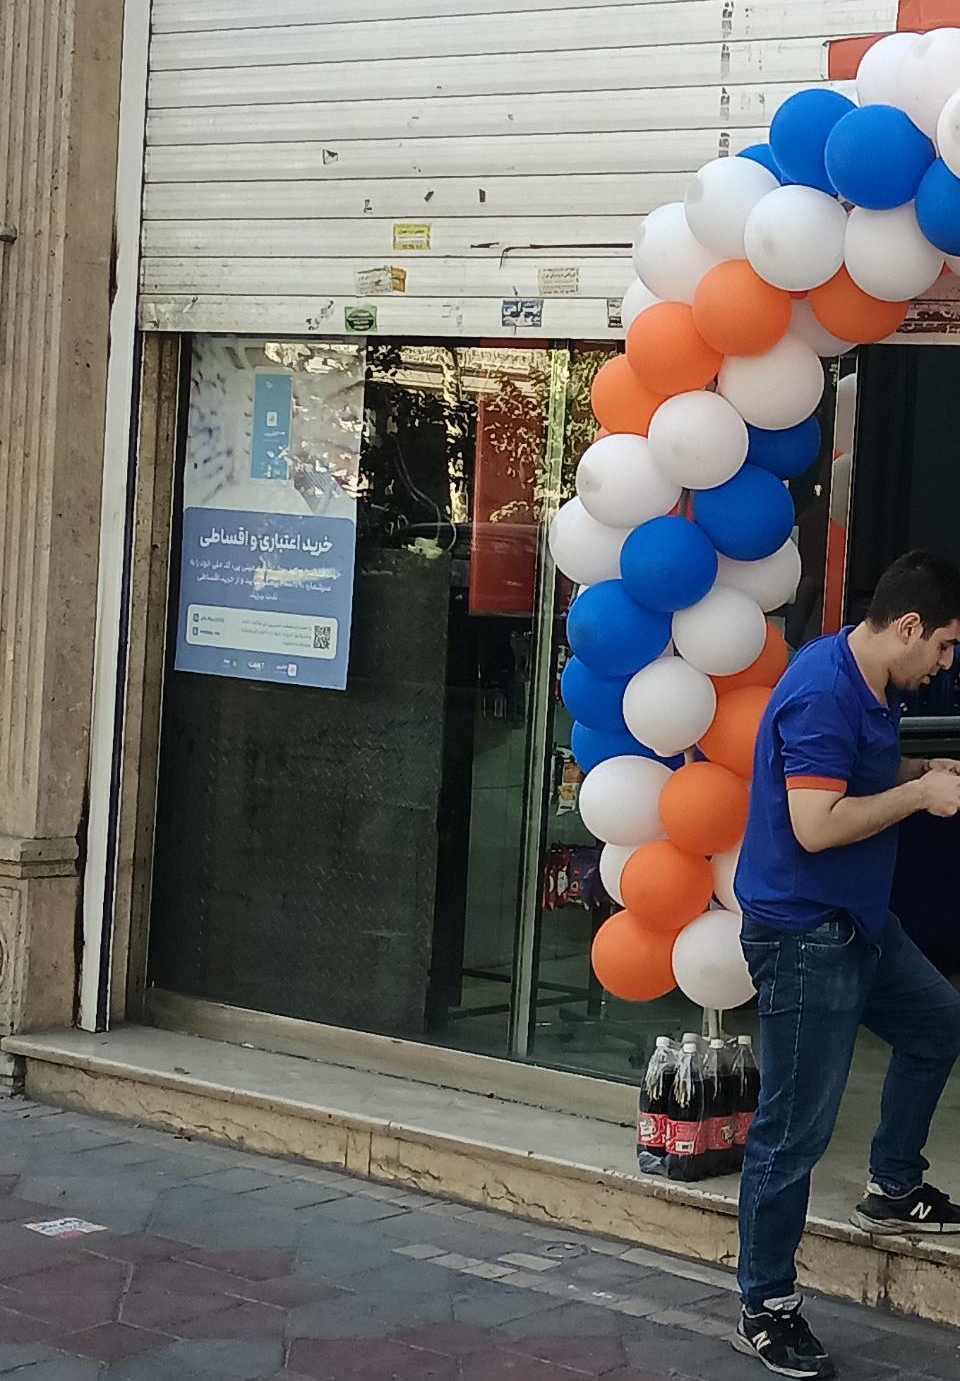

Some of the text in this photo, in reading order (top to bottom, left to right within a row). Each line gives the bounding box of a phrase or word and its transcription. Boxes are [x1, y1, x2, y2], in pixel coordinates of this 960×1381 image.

[200, 527, 333, 556] خرید اعتباری و اقساطی
[910, 1202, 932, 1220] N
[752, 1330, 772, 1351] N
